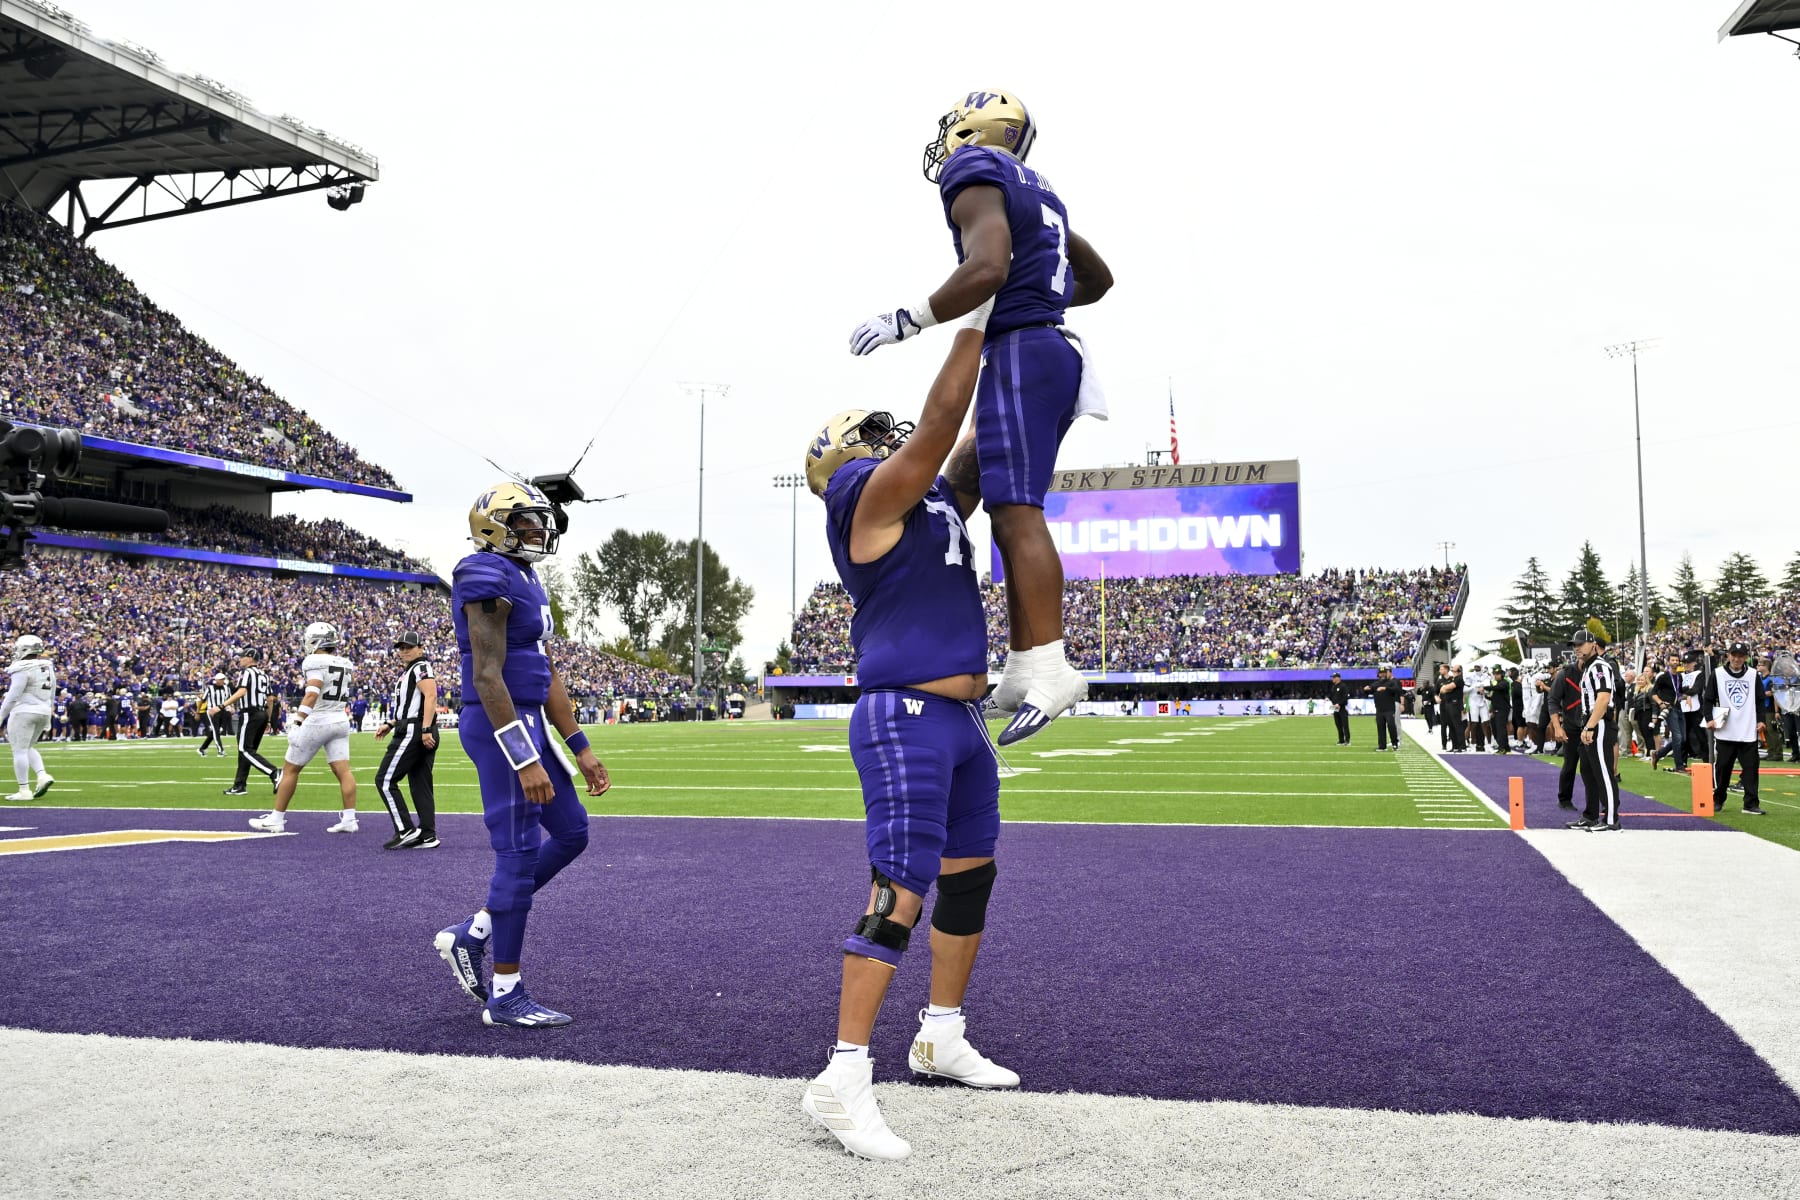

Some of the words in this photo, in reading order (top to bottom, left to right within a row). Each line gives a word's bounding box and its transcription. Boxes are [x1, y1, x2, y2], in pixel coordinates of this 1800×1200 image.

[964, 91, 998, 110] W
[1041, 203, 1067, 296] 7
[810, 426, 831, 460] W
[1048, 471, 1115, 491] SKY
[1131, 463, 1267, 486] STADIUM
[476, 491, 497, 512] W
[924, 499, 976, 572] 7
[1046, 514, 1281, 554] UCHDOWN
[902, 697, 925, 717] W
[1159, 704, 1169, 713] 40
[1733, 695, 1743, 704] 12
[525, 713, 535, 729] W
[912, 1047, 937, 1073] didas
